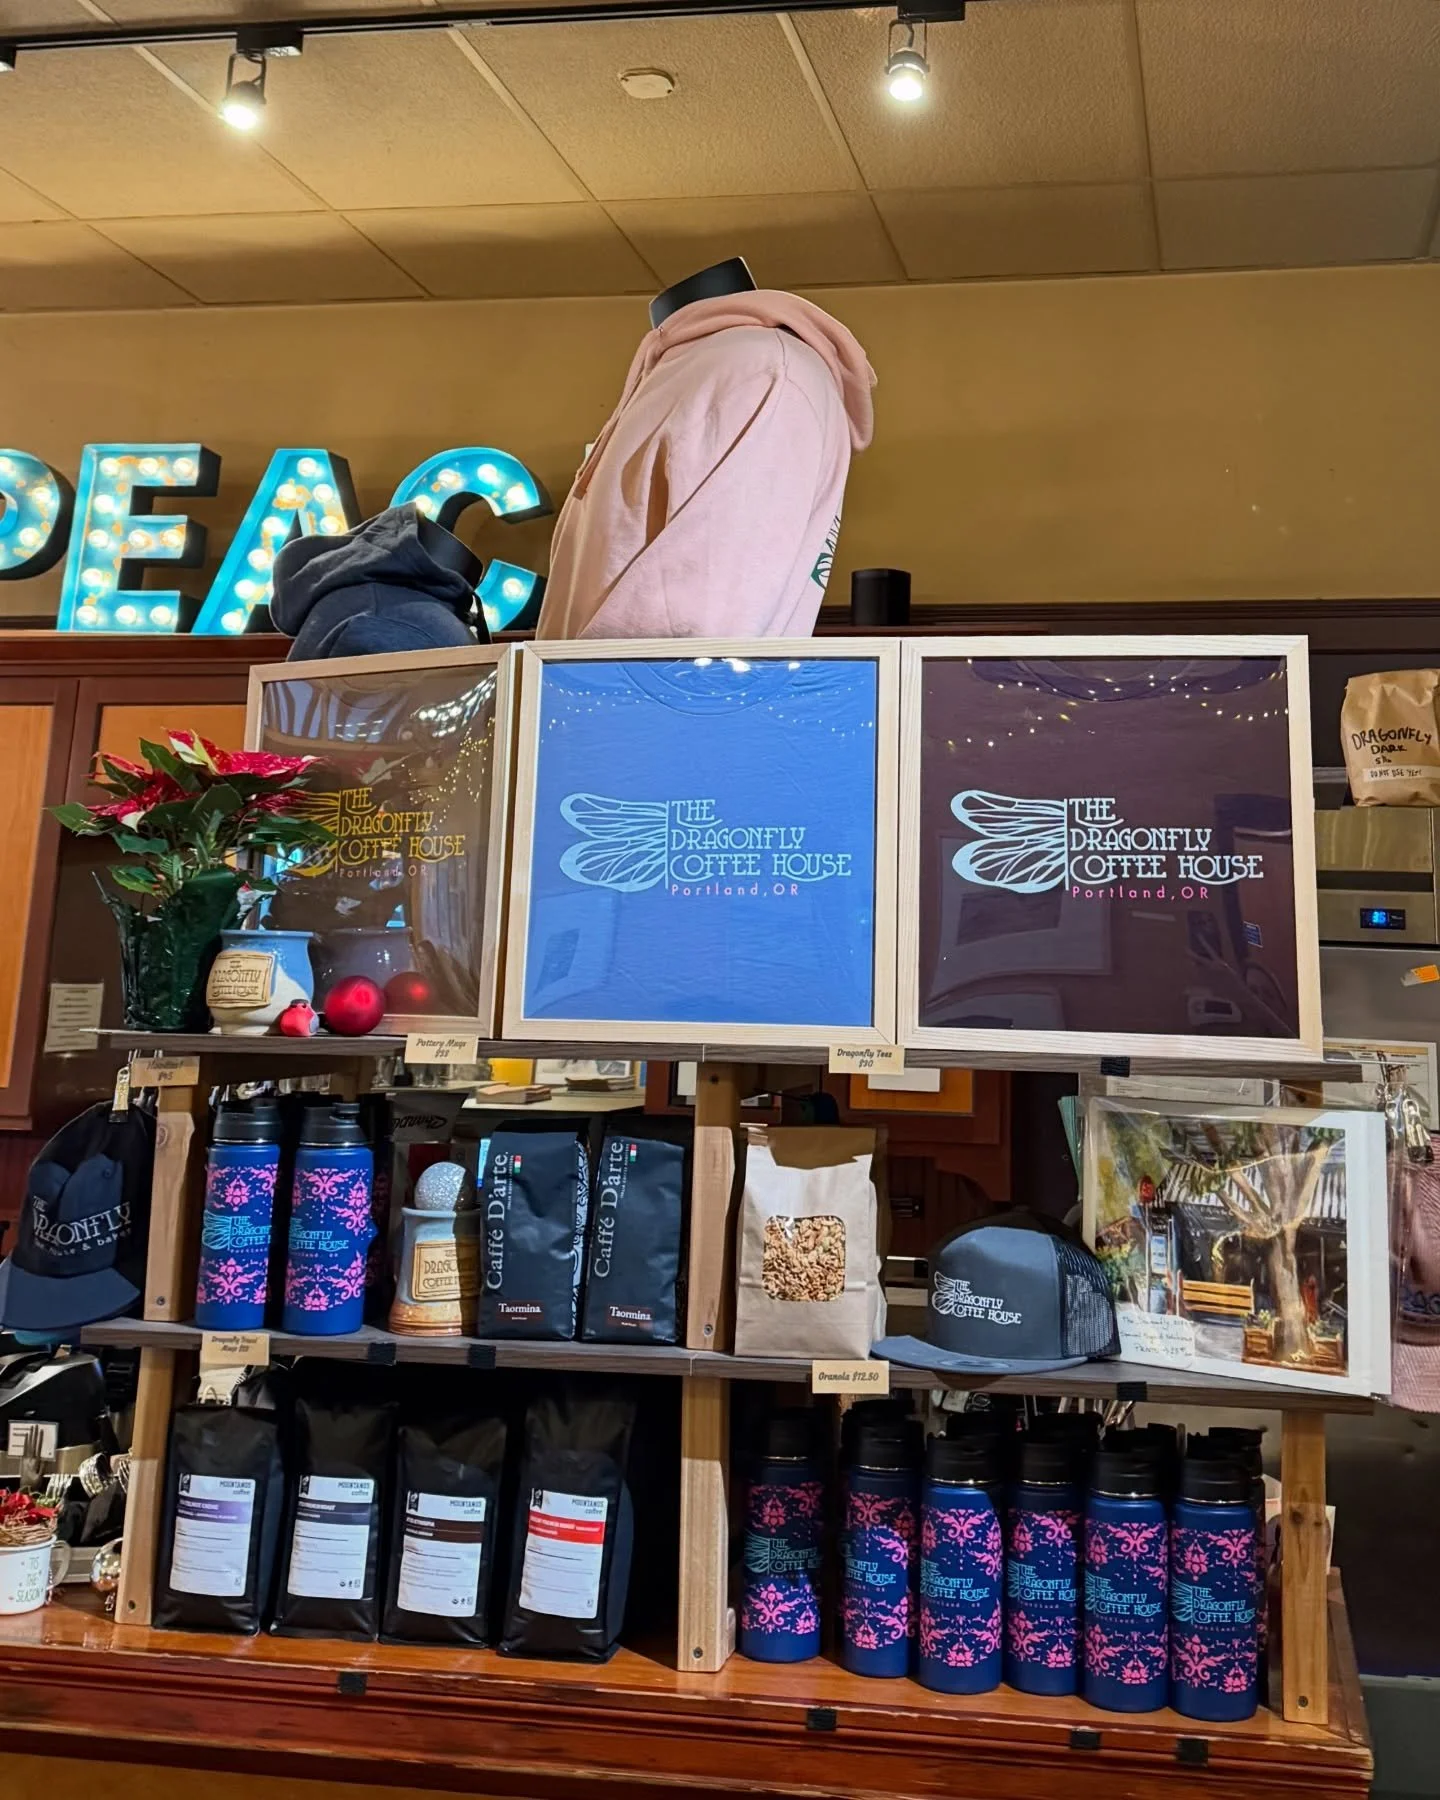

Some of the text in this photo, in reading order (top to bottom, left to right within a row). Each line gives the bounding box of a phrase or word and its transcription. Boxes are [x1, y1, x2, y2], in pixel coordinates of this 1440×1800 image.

[1352, 726, 1432, 750] DRAGONFLY
[1370, 744, 1407, 755] DARK
[342, 787, 376, 815] THE
[1069, 797, 1124, 828] THE
[340, 811, 434, 837] DRAGONFLY
[671, 799, 723, 828] THE
[671, 827, 806, 850] DRAGONFLY
[1069, 828, 1212, 851] DRAGONFLY
[339, 835, 466, 866] COFFEE HOUSE
[670, 853, 852, 882] COFFEE HOUSE
[1069, 854, 1264, 885] COFFEE HOUSE
[837, 1048, 892, 1058] Dragonfly Tees
[594, 1216, 615, 1277] Caffé
[487, 1229, 504, 1290] Caffé
[956, 1280, 973, 1294] THE
[954, 1292, 1004, 1310] DRAGONFLY
[953, 1304, 1022, 1325] COFFEE HOUSE
[818, 1370, 879, 1382] Granola $12.50
[866, 1572, 896, 1586] HOUSE
[960, 1587, 990, 1602] HOUSE
